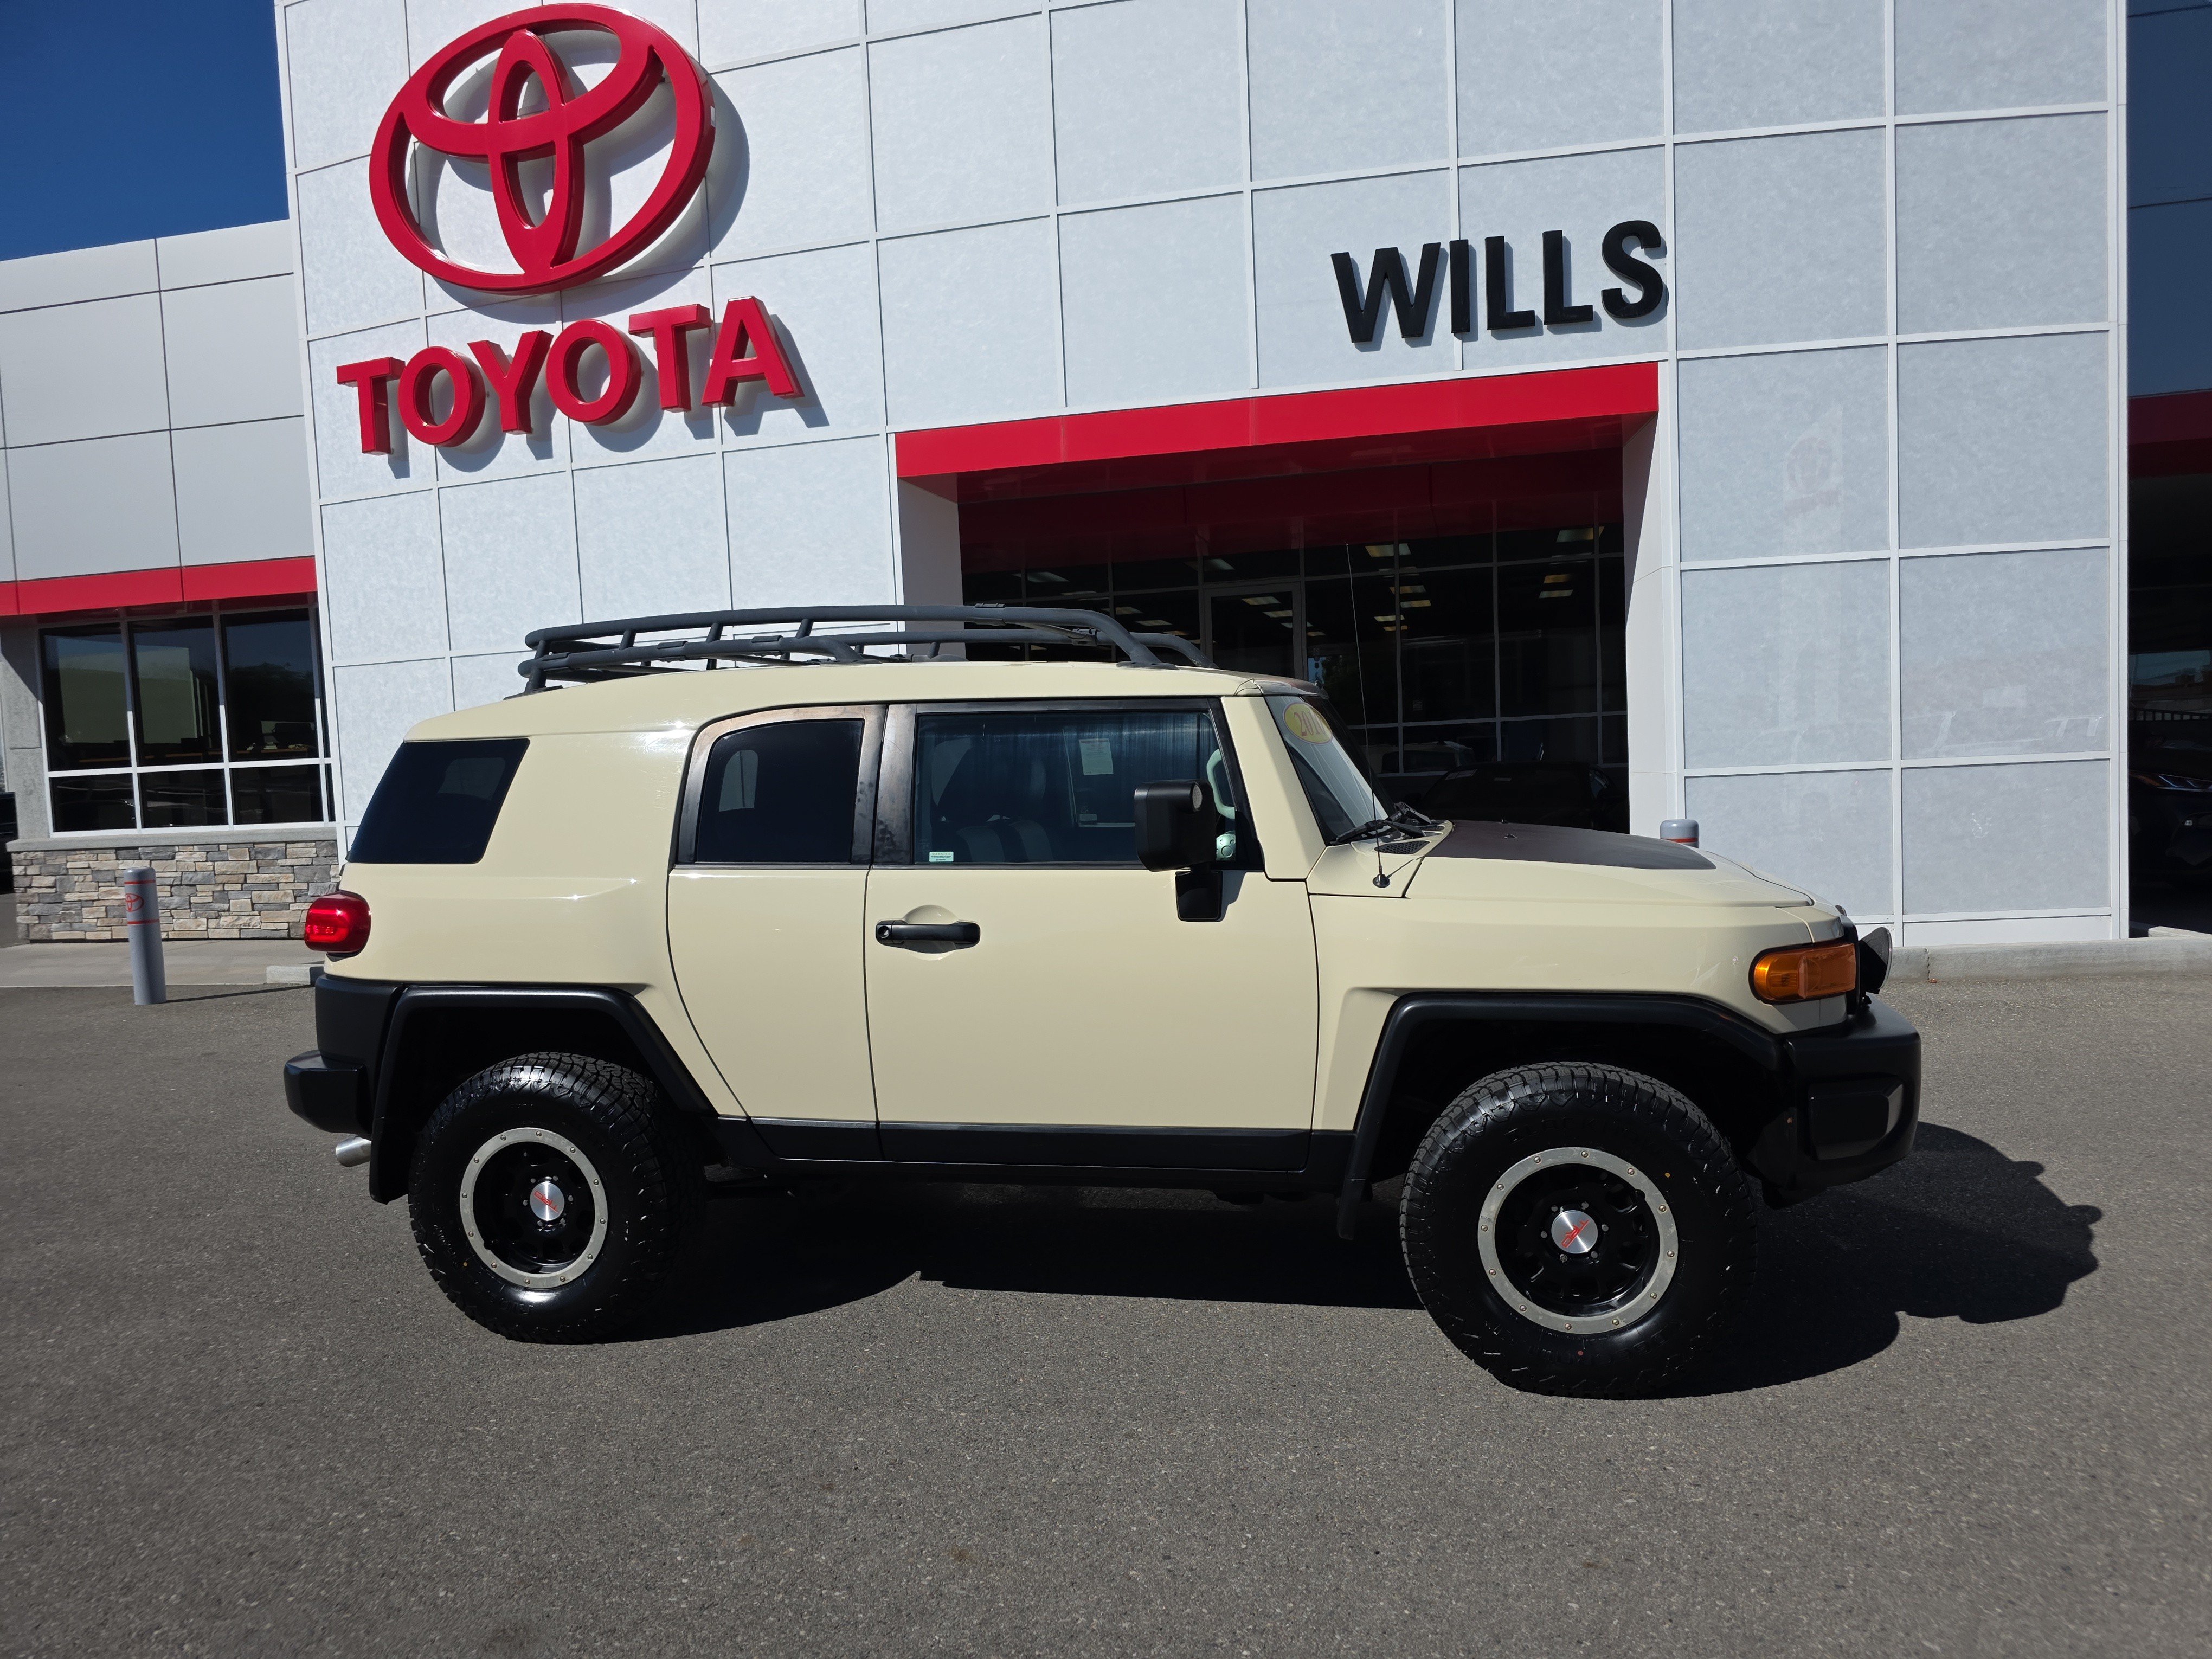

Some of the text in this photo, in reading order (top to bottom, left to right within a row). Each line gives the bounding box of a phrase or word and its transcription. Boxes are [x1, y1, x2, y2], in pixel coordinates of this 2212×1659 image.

[1330, 220, 1663, 343] WILLS
[336, 295, 805, 455] TOYOTA
[534, 1191, 559, 1214] TRD
[1561, 1219, 1589, 1248] TRD
